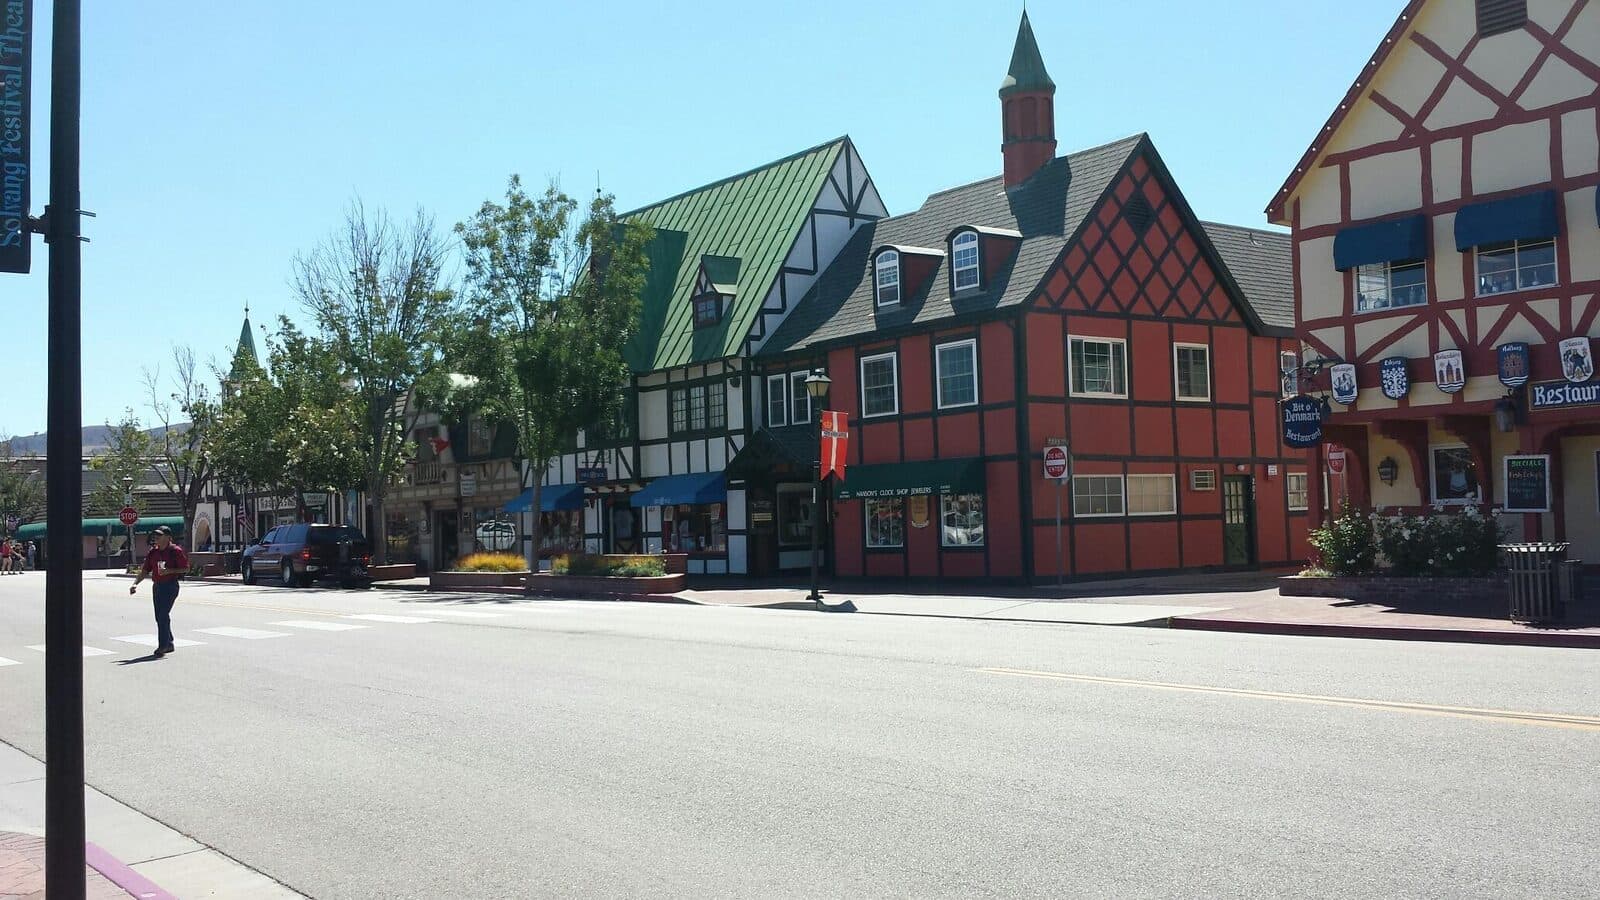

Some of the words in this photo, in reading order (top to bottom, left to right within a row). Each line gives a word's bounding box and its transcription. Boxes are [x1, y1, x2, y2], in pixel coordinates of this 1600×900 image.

[0, 65, 23, 155] Festival
[0, 161, 27, 248] Solvang
[1534, 384, 1600, 406] Restaur
[1285, 407, 1321, 423] Denmark
[1292, 403, 1305, 412] Bit
[1286, 427, 1322, 442] Restaurant
[896, 488, 909, 496] SHOP
[120, 512, 137, 521] STOP
